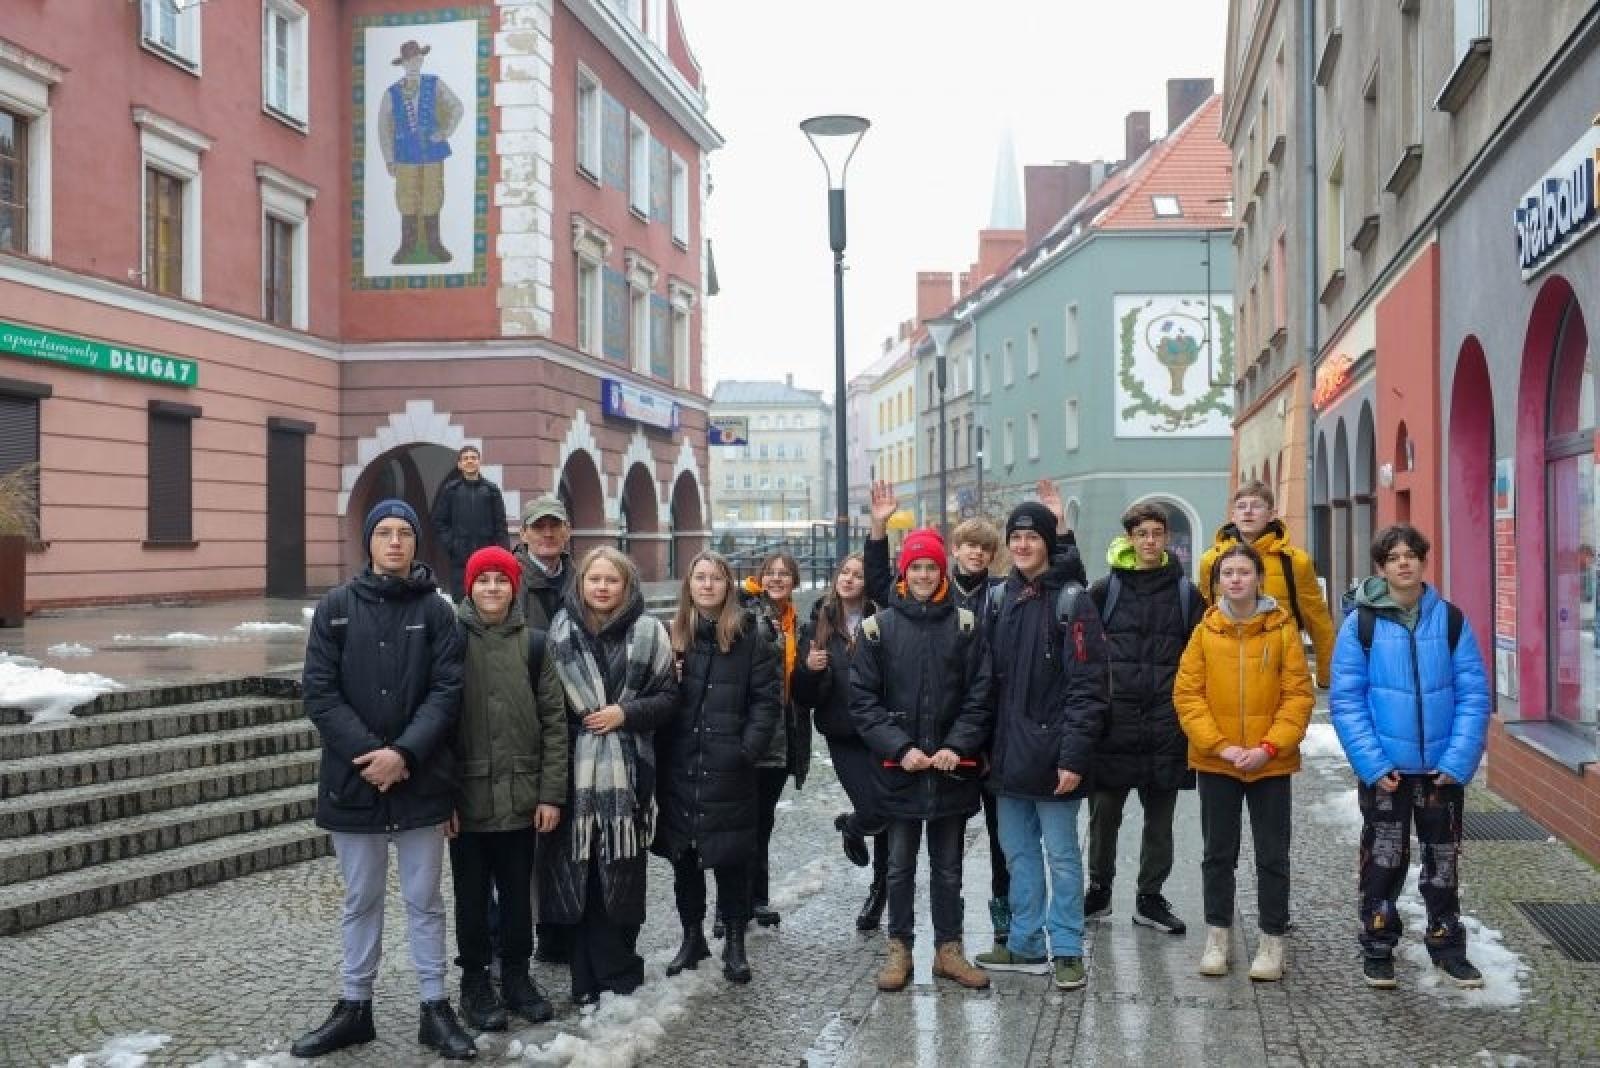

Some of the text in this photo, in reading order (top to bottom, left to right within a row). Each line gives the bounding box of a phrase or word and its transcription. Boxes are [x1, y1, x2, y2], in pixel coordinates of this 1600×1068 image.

[3, 334, 191, 381] apartamenty DŁUGA 7
